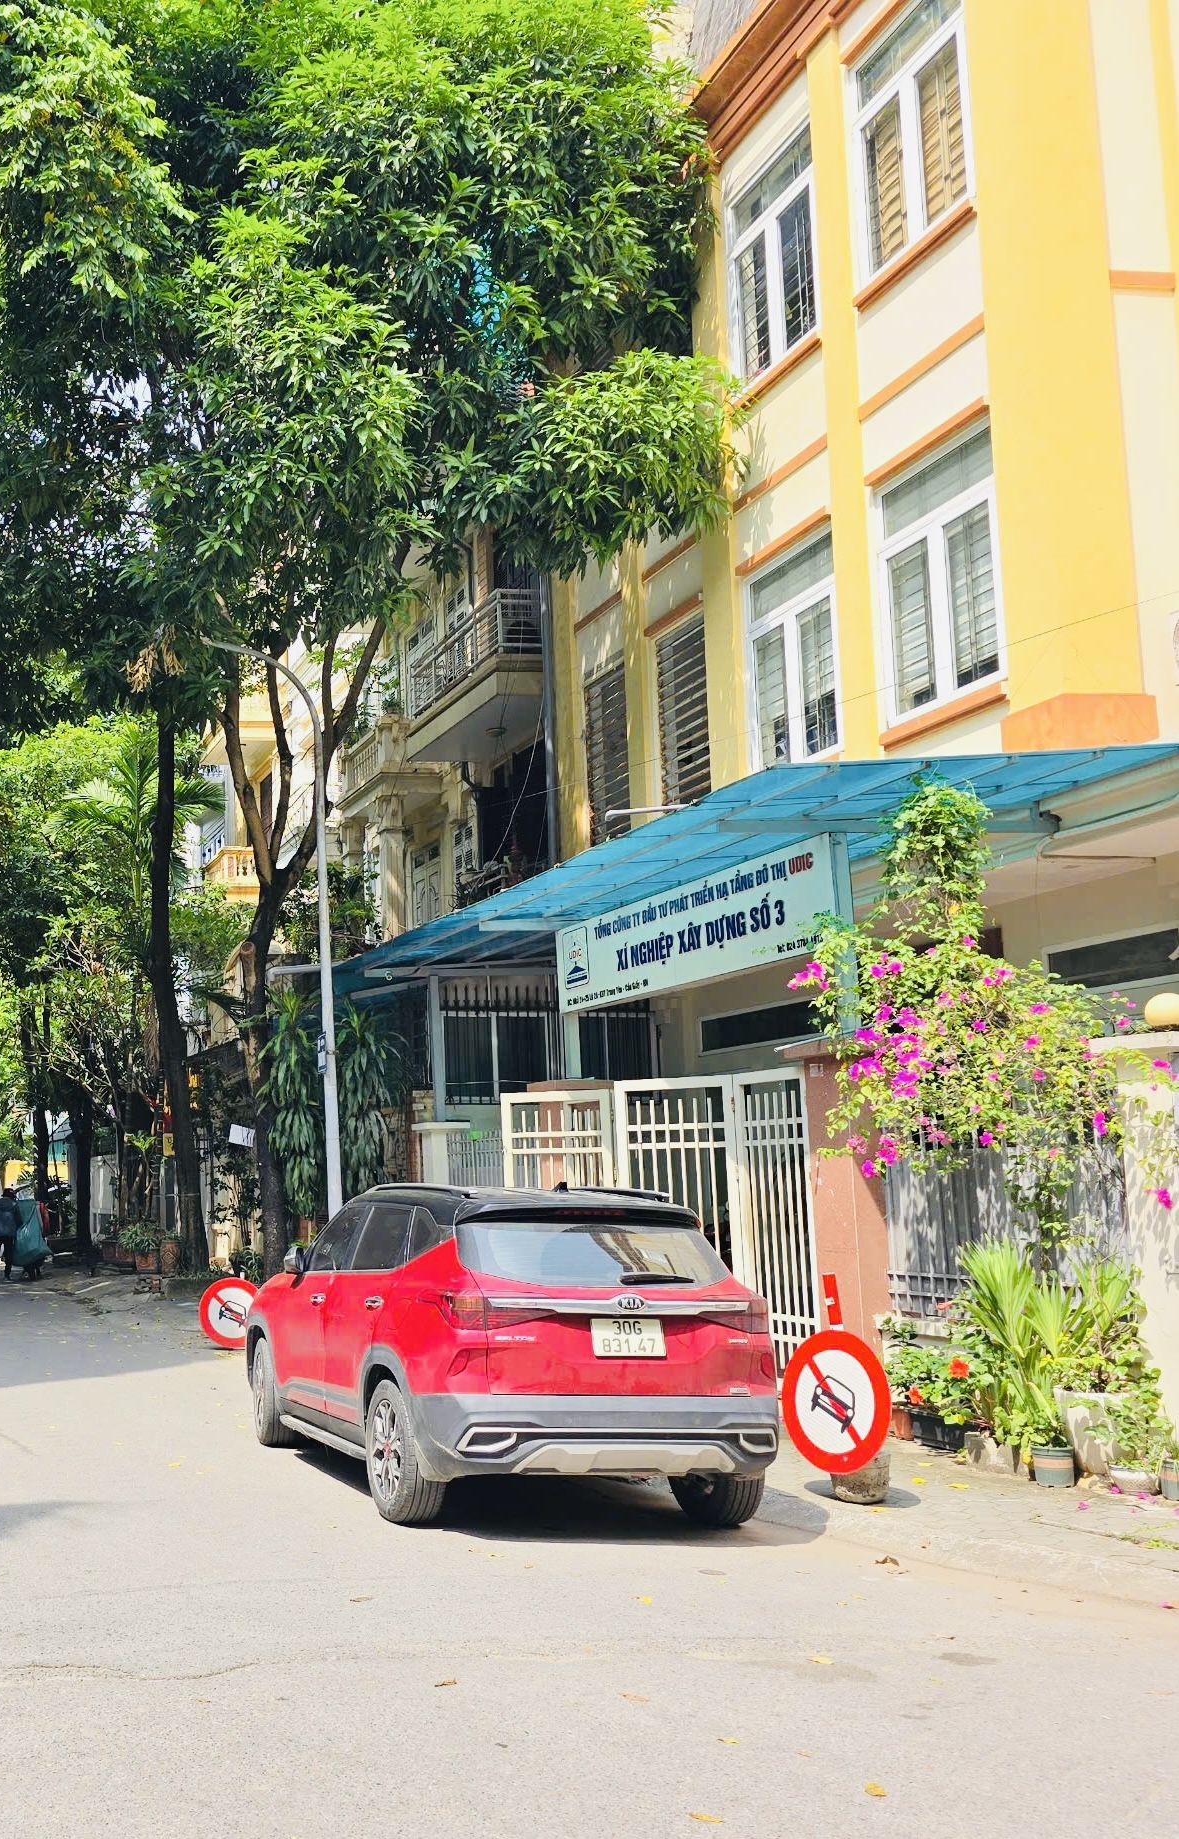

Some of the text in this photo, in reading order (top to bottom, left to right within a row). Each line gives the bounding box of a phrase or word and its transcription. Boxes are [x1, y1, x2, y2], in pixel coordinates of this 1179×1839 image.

[594, 851, 814, 940] TỔNG CÔNG TY ĐẦU TƯ PHÁT TRIỂN HẠ TẦNG ĐÔ THỊ UDIC
[616, 892, 786, 972] XÍ NGHIỆP XÂY DỰNG SỐ 3
[568, 948, 582, 960] UDIC
[620, 1298, 642, 1308] KIA
[612, 1320, 643, 1336] 30G
[602, 1338, 656, 1353] 831.47
